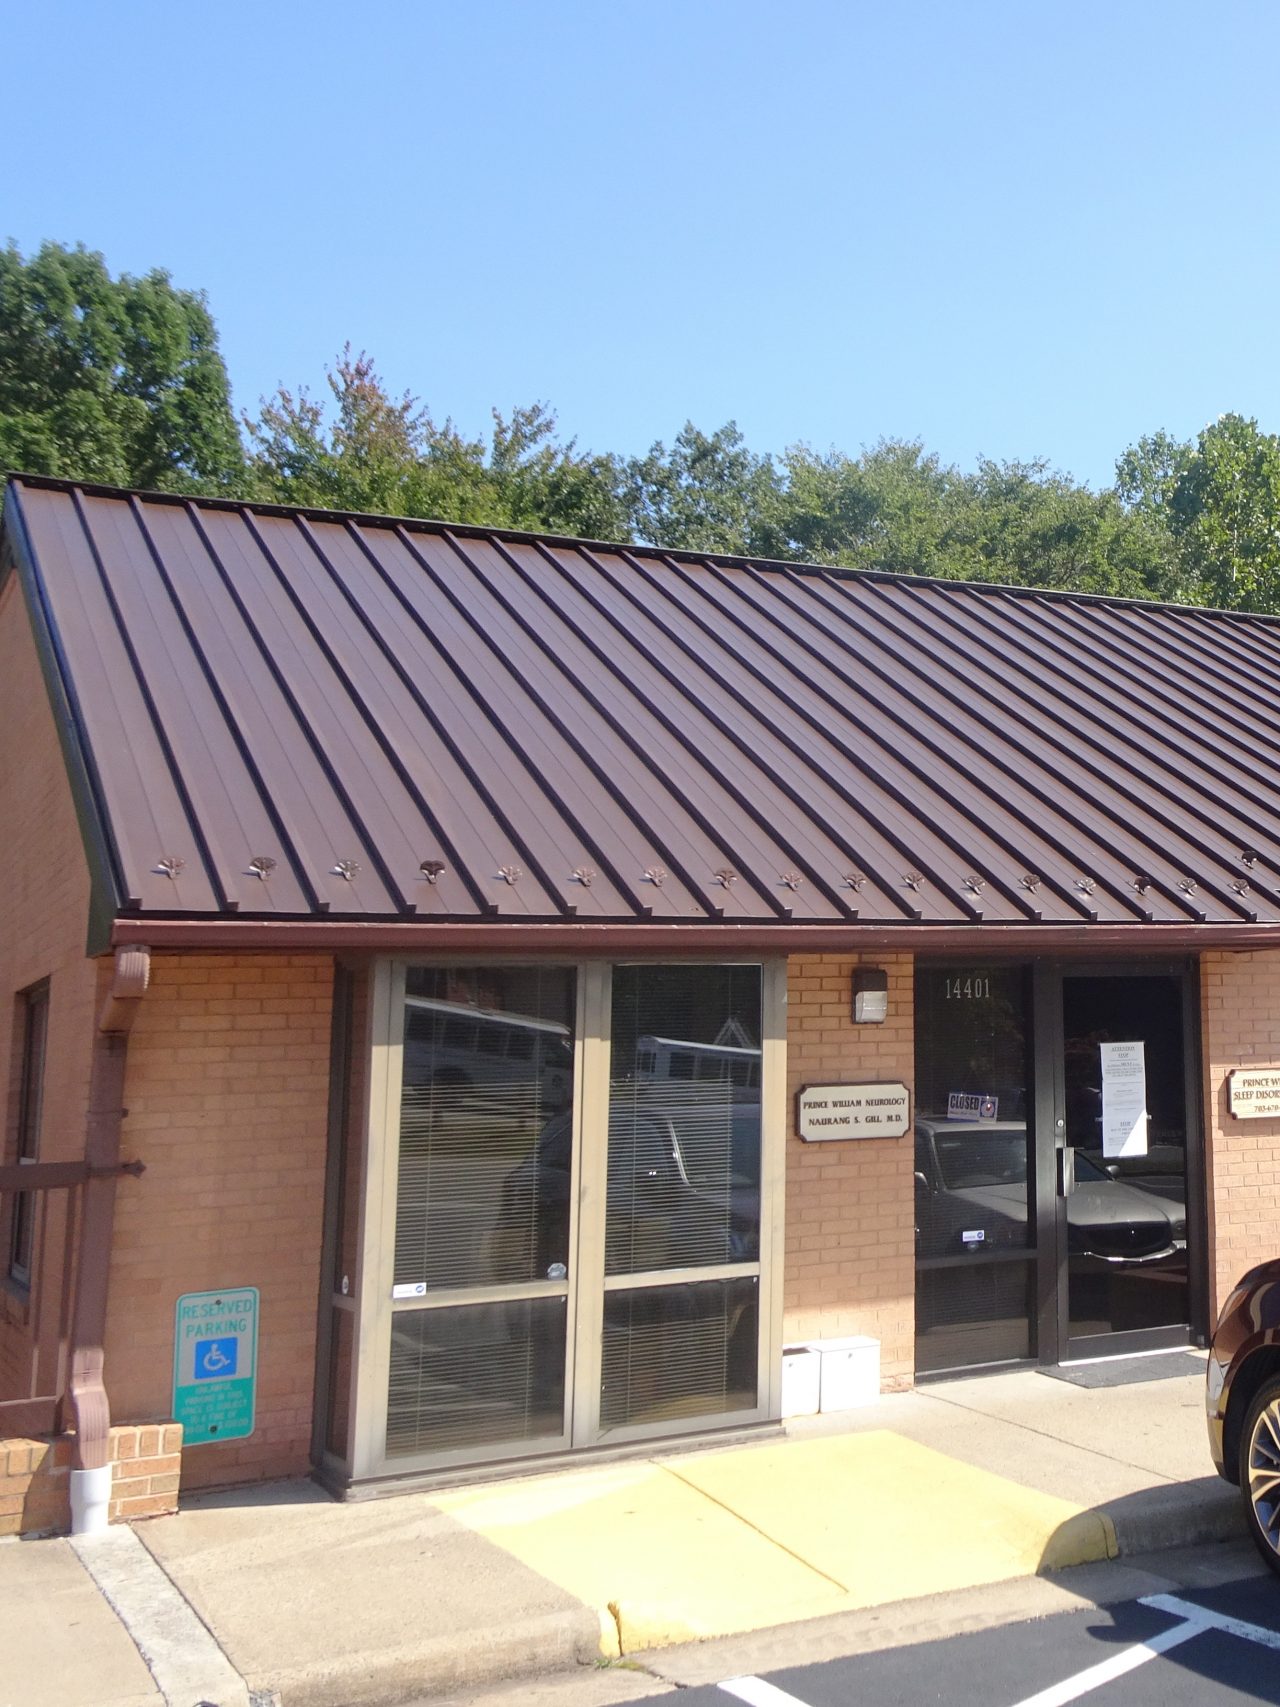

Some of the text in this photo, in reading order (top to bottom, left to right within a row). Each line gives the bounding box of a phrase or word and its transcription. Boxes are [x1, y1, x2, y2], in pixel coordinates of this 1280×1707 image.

[946, 977, 990, 999] 14401
[1242, 1078, 1269, 1087] PRINCE
[950, 1094, 980, 1111] CLOSED
[1234, 1090, 1254, 1100] SLEEP
[803, 1097, 906, 1110] PRINCE WILLIAM NEUROLOGY
[808, 1116, 851, 1126] NAURANG
[854, 1116, 861, 1124] S.
[886, 1114, 903, 1123] M.D.
[183, 1299, 253, 1319] RESERVED
[186, 1318, 247, 1338] PARKING
